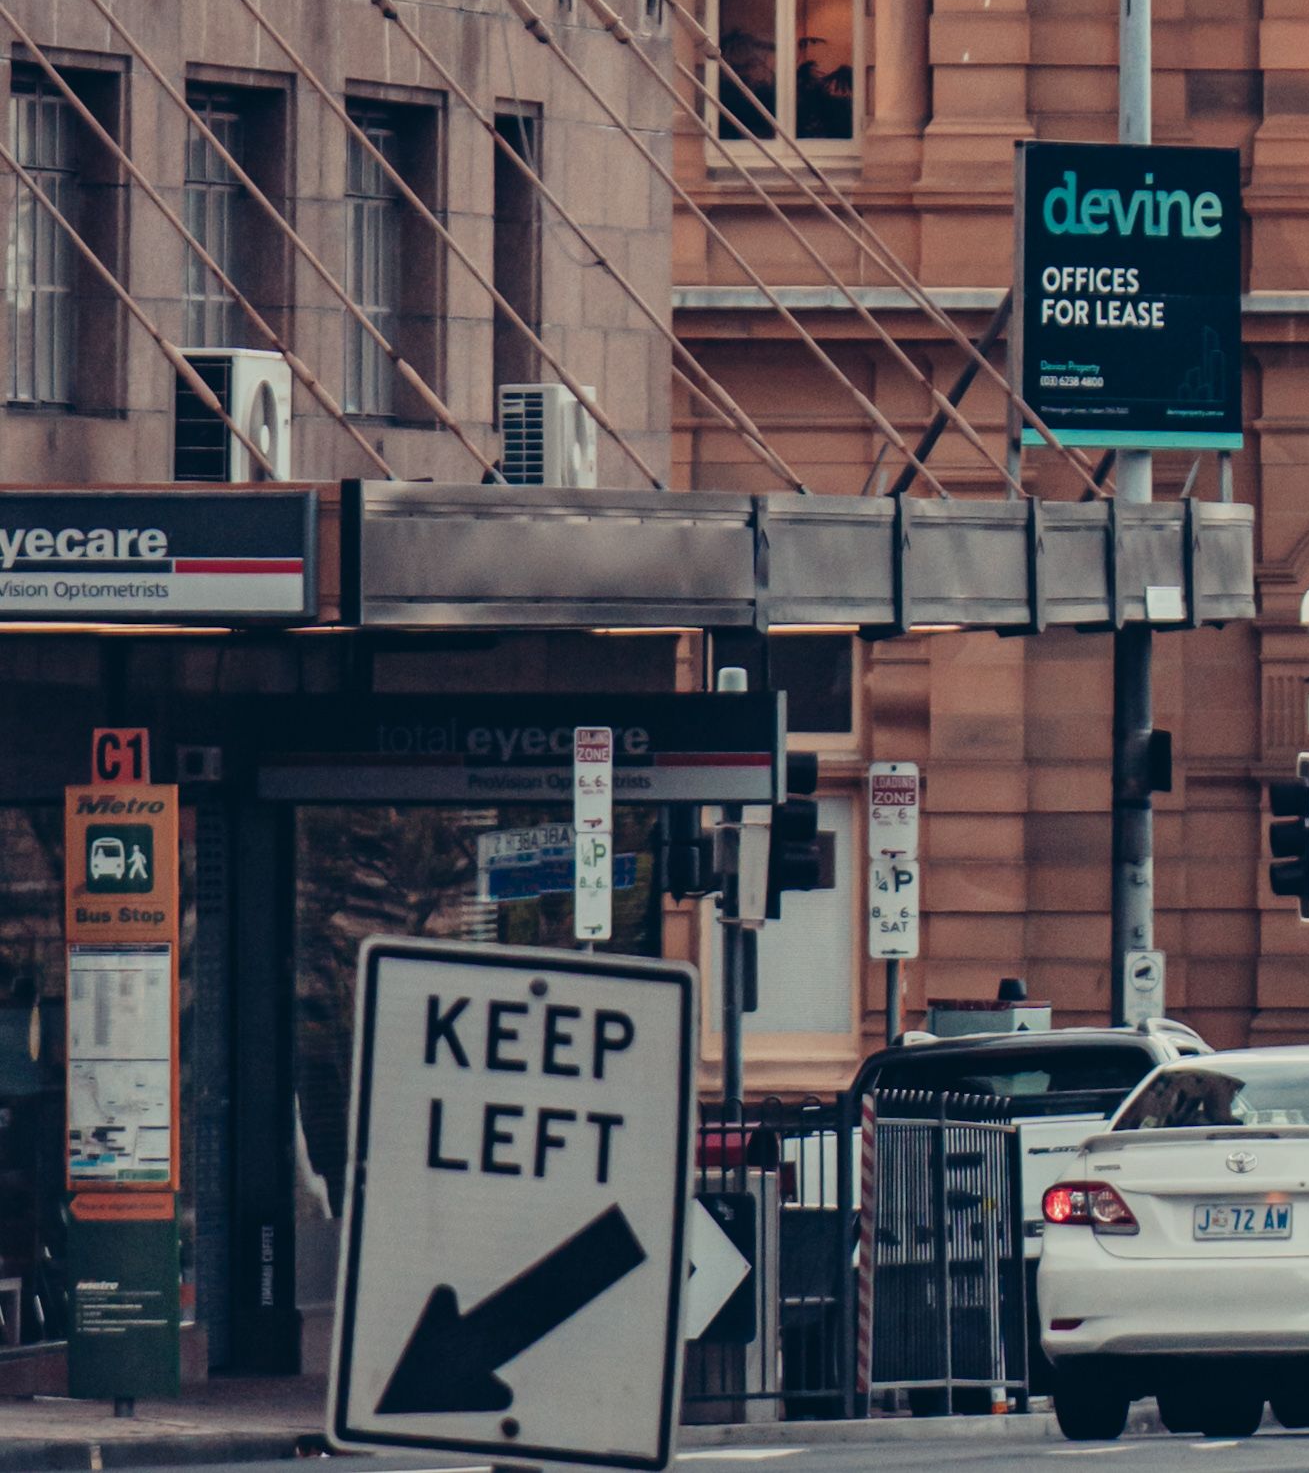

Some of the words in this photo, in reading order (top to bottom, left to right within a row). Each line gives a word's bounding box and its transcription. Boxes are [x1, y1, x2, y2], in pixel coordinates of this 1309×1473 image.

[1043, 170, 1223, 238] devine
[1042, 266, 1140, 294] OFFICES
[1042, 299, 1089, 326] FOR
[1095, 300, 1165, 328] LEASE
[54, 582, 169, 600] Optometrists
[467, 727, 650, 762] eyecre
[576, 747, 609, 760] ZONE
[97, 733, 143, 780] C1
[873, 776, 916, 789] LOADING
[76, 797, 165, 815] Metro
[873, 791, 915, 804] ZONE
[76, 908, 112, 923] Bus
[118, 908, 165, 925] Stop
[881, 921, 909, 932] SAT
[424, 994, 635, 1079] KEEP
[427, 1098, 624, 1184] LEFT
